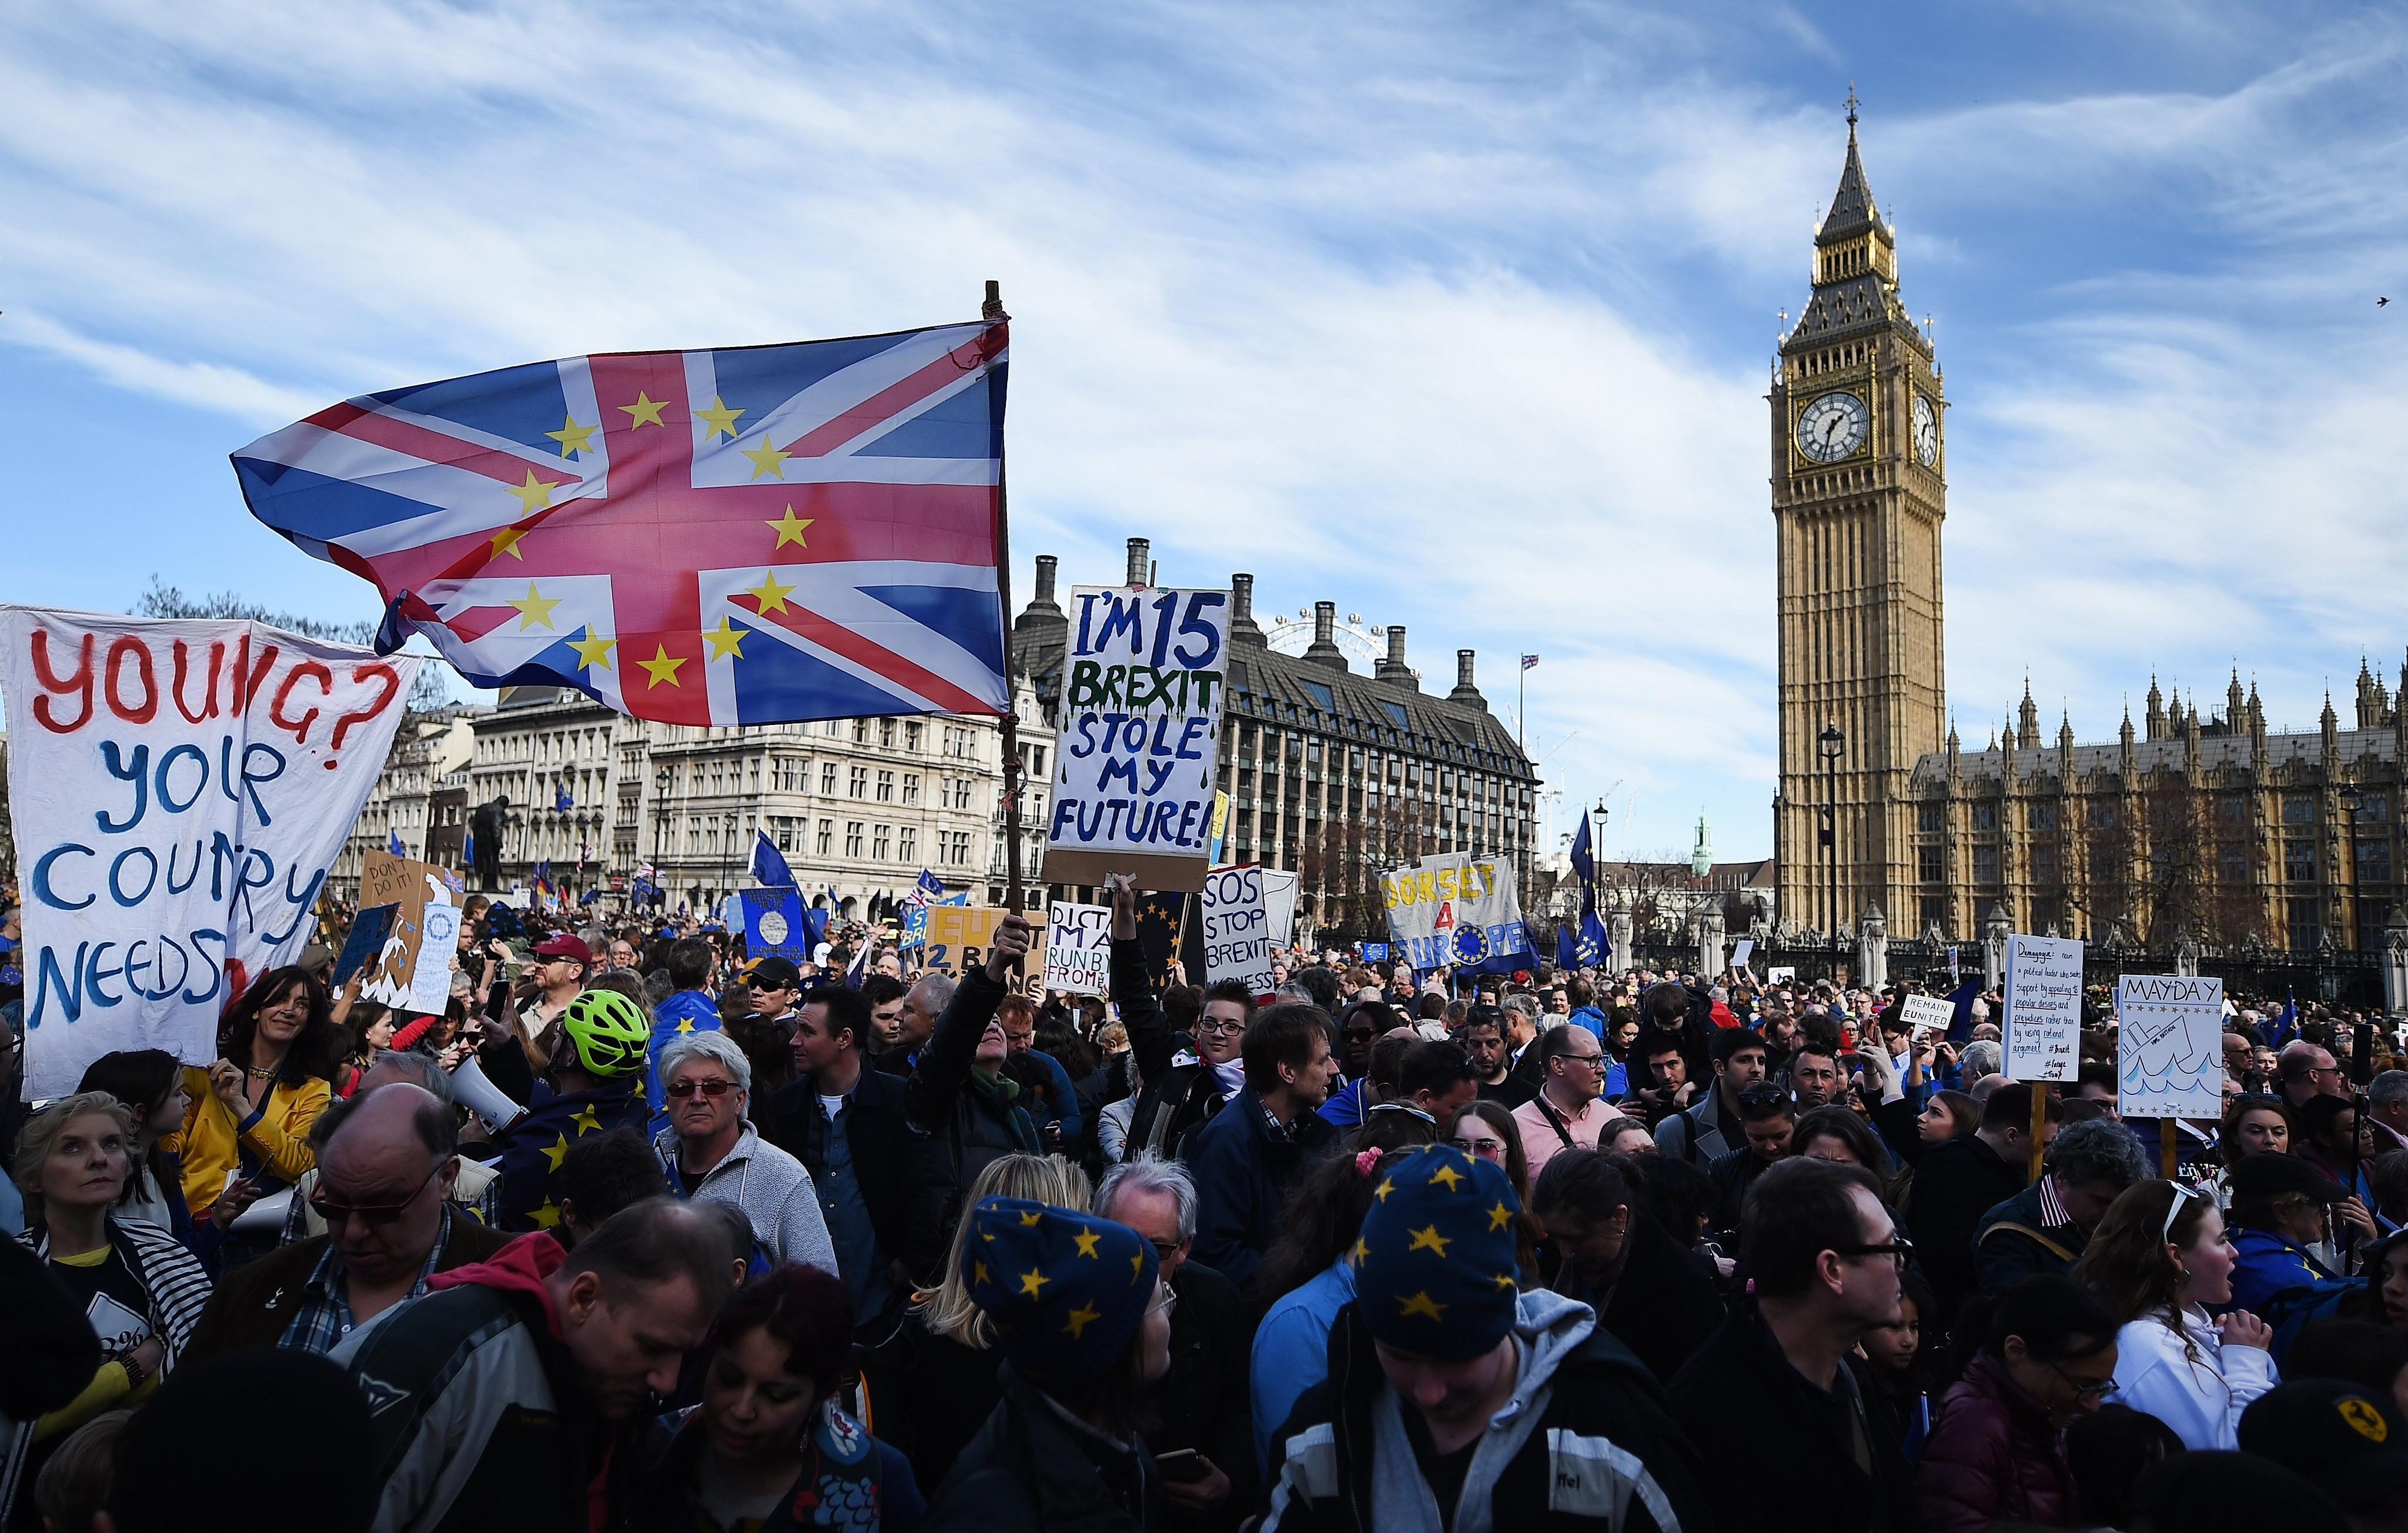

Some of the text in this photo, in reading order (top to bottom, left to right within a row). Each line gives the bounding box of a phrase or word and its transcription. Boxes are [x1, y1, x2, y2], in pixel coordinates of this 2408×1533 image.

[1071, 591, 1226, 669] I'M 15
[1068, 660, 1223, 712] BREXIT
[31, 629, 400, 770] YOUNG?
[1070, 712, 1209, 760] STOLE
[1096, 756, 1175, 796] MY
[1049, 799, 1214, 848] FUTURE!
[369, 859, 406, 880] DON'T
[32, 830, 325, 944] COUNRY
[374, 873, 413, 896] DO IT!
[1203, 869, 1261, 908] SOS
[1382, 863, 1494, 910] DORSET
[934, 907, 991, 946] EU
[1205, 909, 1266, 940] STOP
[1434, 902, 1454, 930] 4
[928, 944, 951, 968] 2
[1049, 947, 1087, 970] RUN
[1205, 937, 1269, 968] BREXIT
[27, 929, 227, 1029] NEEDS
[1048, 966, 1096, 987] FROM
[2024, 967, 2043, 978] political
[2045, 967, 2058, 977] leader
[2060, 970, 2069, 978] who
[2041, 983, 2048, 998] by
[2048, 984, 2072, 1000] appealing
[2073, 984, 2078, 993] to
[2125, 978, 2218, 1002] MAYDAY
[1904, 1010, 1947, 1025] EUNITED
[1910, 998, 1948, 1012] REMAIN
[2015, 998, 2069, 1011] popular desires and
[2015, 1014, 2075, 1026] prejudices rather than
[2015, 1026, 2064, 1043] by using rational
[2012, 1042, 2042, 1058] argument
